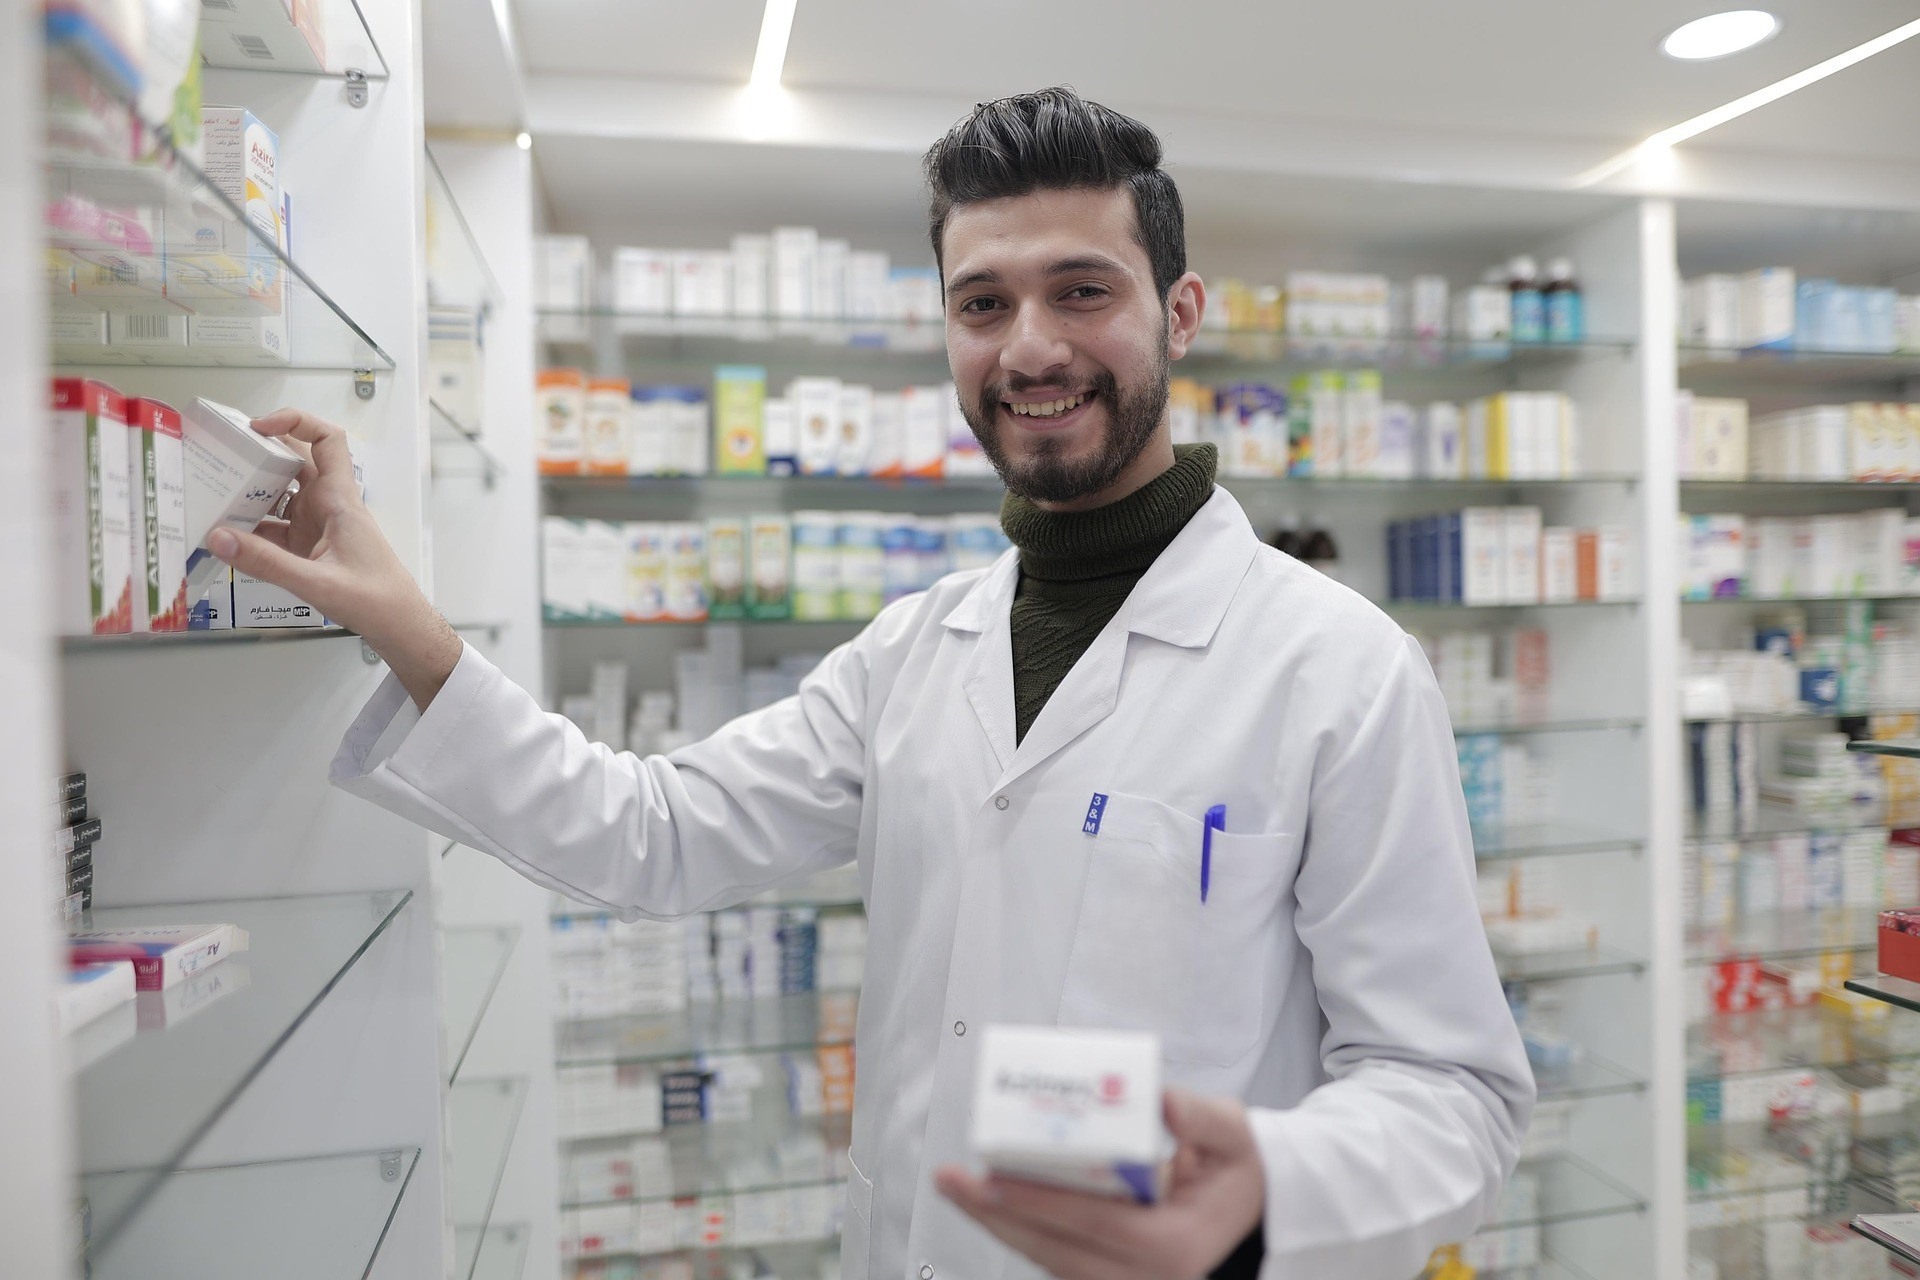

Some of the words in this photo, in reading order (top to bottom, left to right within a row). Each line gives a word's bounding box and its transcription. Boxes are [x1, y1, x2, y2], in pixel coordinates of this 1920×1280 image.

[252, 141, 275, 168] Aziro
[146, 479, 160, 588] ADCEF
[250, 605, 270, 615] فارم
[271, 605, 292, 615] ميجا
